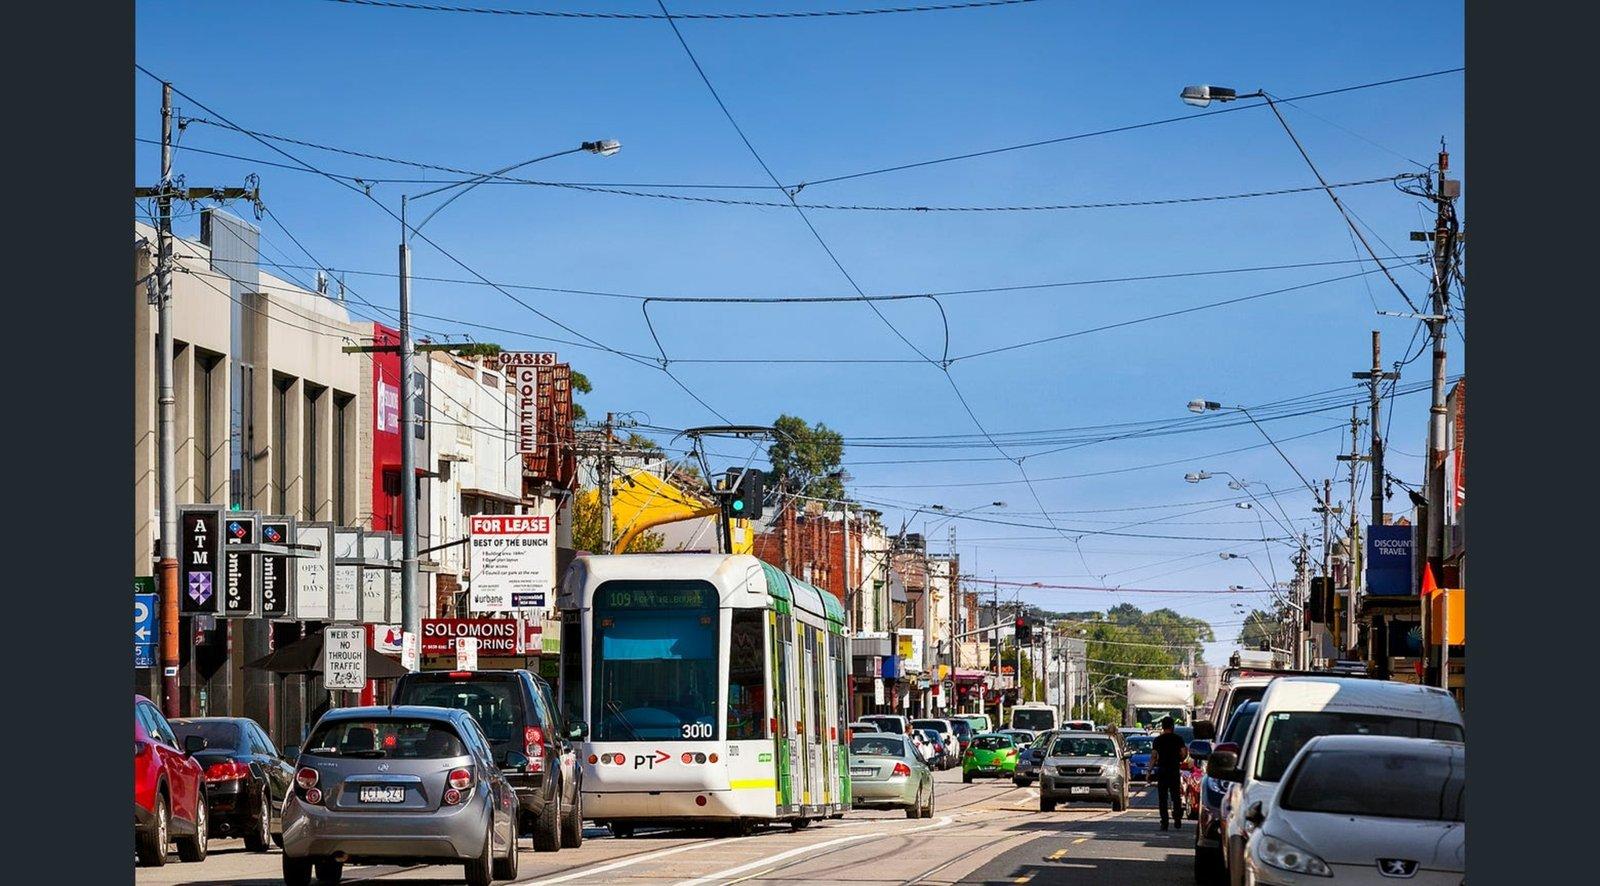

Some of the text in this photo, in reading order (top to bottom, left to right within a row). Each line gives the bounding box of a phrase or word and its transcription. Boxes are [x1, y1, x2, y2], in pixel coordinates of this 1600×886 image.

[500, 353, 552, 364] OASIS
[521, 371, 533, 451] COFFEE
[474, 519, 547, 532] FOR LEASE
[193, 519, 209, 565] ATM
[473, 539, 548, 547] BEST OF THE BUNCH
[1374, 539, 1413, 548] DISCOUNT
[1379, 547, 1407, 556] TRAVEL
[302, 564, 325, 572] OPEN
[364, 571, 382, 579] PEN
[264, 557, 277, 611] mino's
[610, 592, 631, 607] 109
[425, 623, 514, 636] SOLOMONS
[331, 631, 360, 639] WEIR ST
[340, 641, 351, 649] NO
[448, 639, 514, 650] FORING
[329, 651, 362, 660] THROUGH
[330, 661, 360, 670] TRAFFIC
[682, 723, 713, 738] 3010
